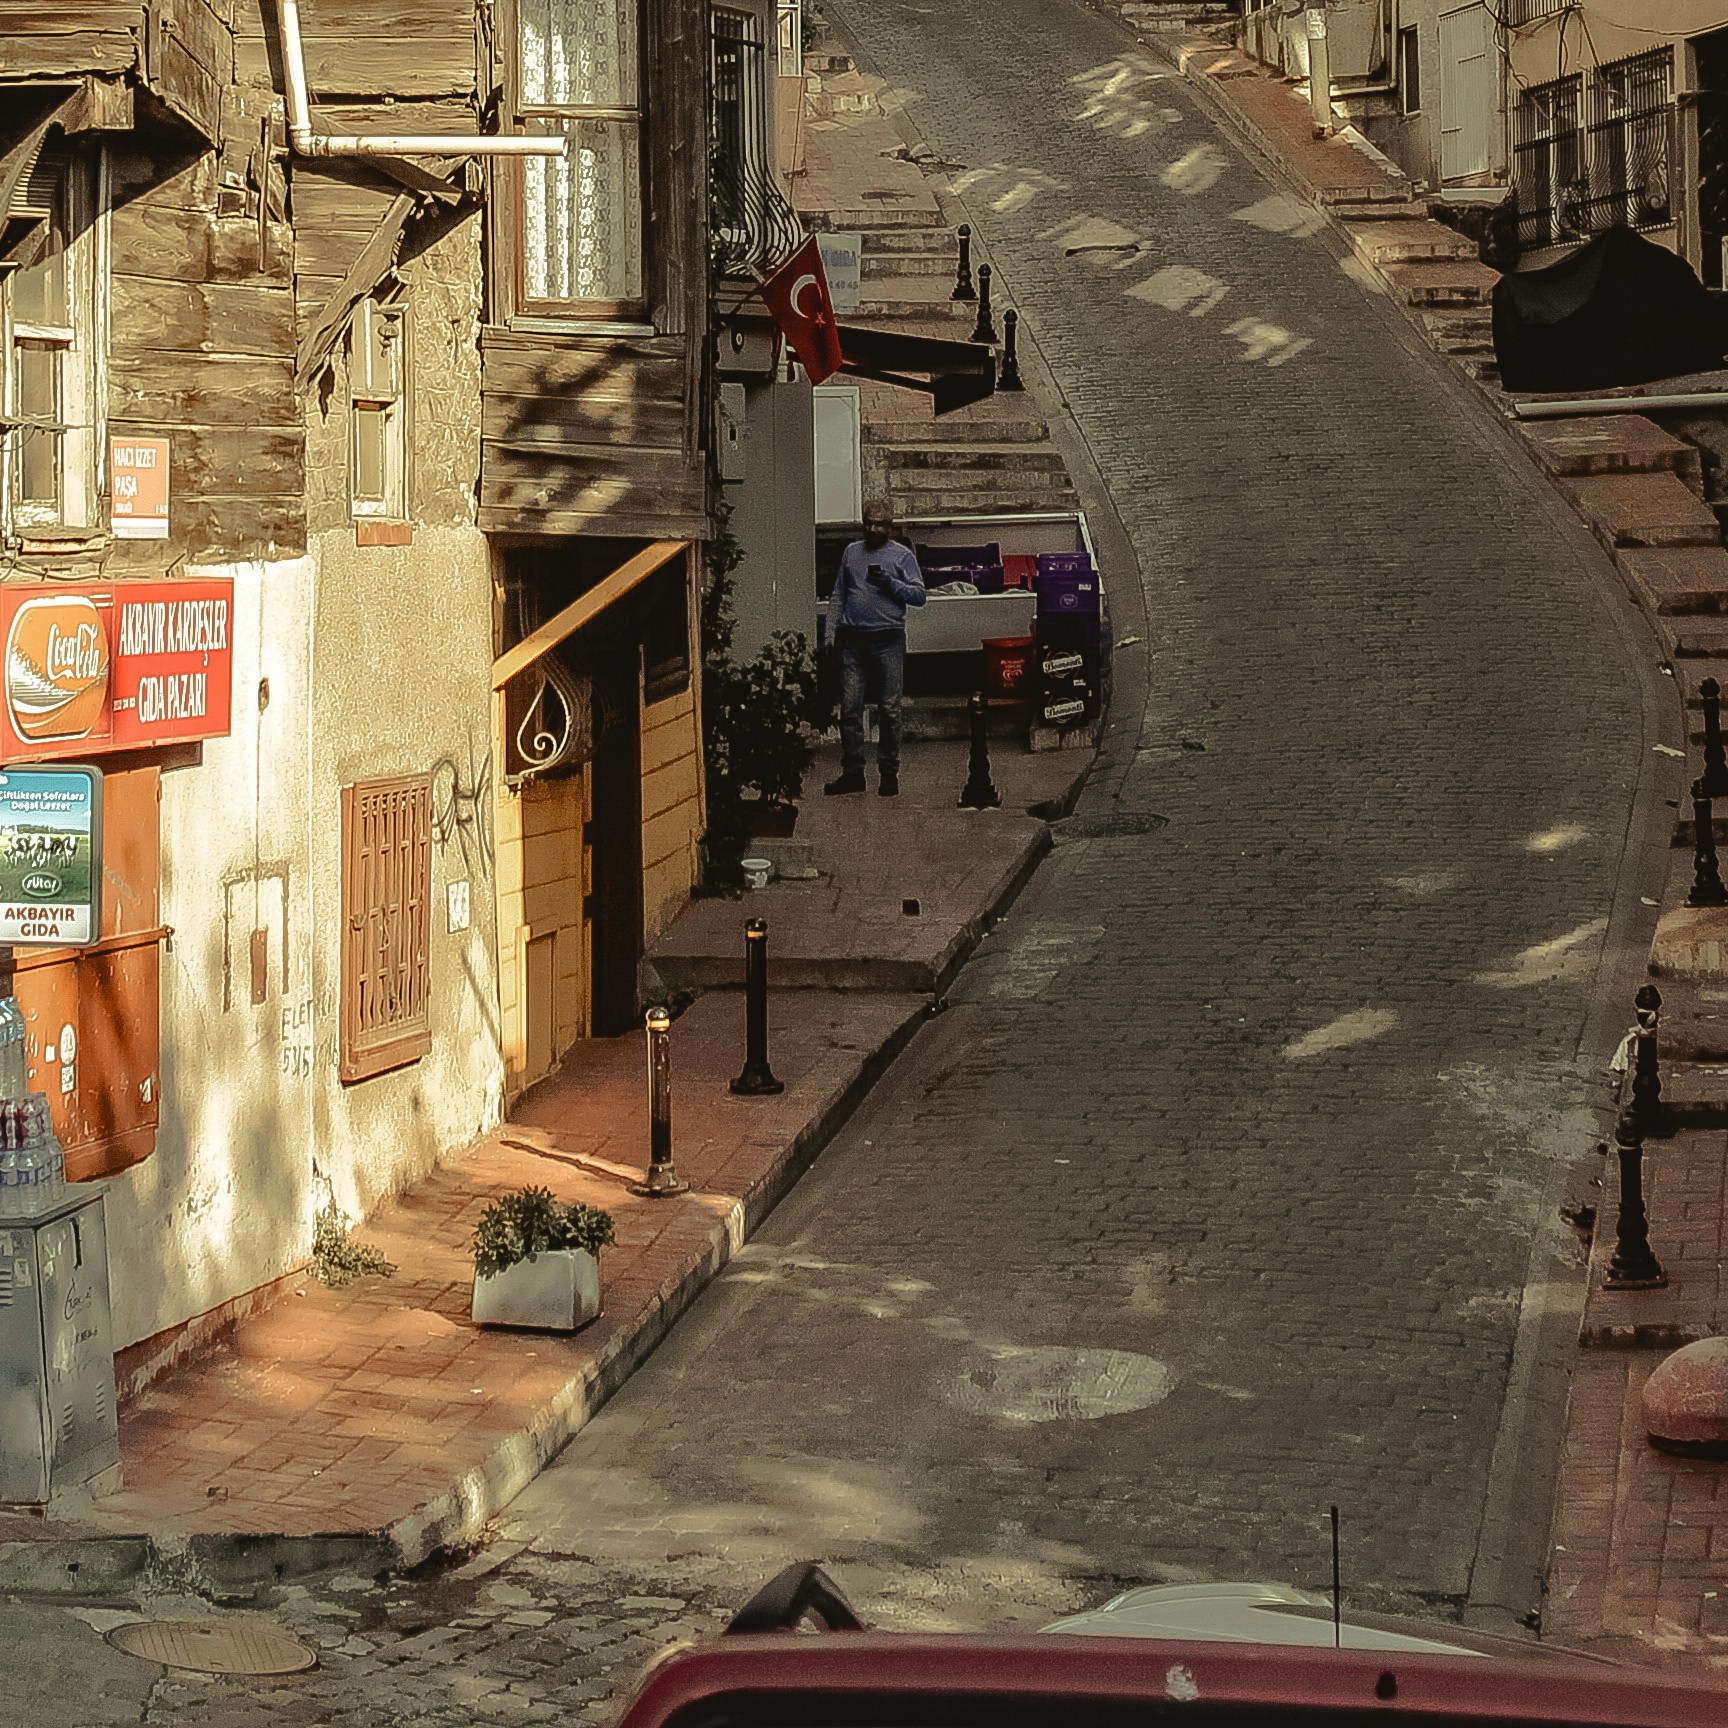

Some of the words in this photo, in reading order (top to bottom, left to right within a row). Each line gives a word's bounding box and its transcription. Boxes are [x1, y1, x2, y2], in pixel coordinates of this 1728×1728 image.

[115, 475, 138, 499] PAŞA
[119, 602, 165, 656] AKBAYIR
[167, 600, 227, 667] KARDEŞLER
[139, 675, 165, 723] GIDA
[167, 673, 207, 719] PAZARI
[4, 907, 75, 922] AKBAYIR
[20, 923, 60, 937] GIDA
